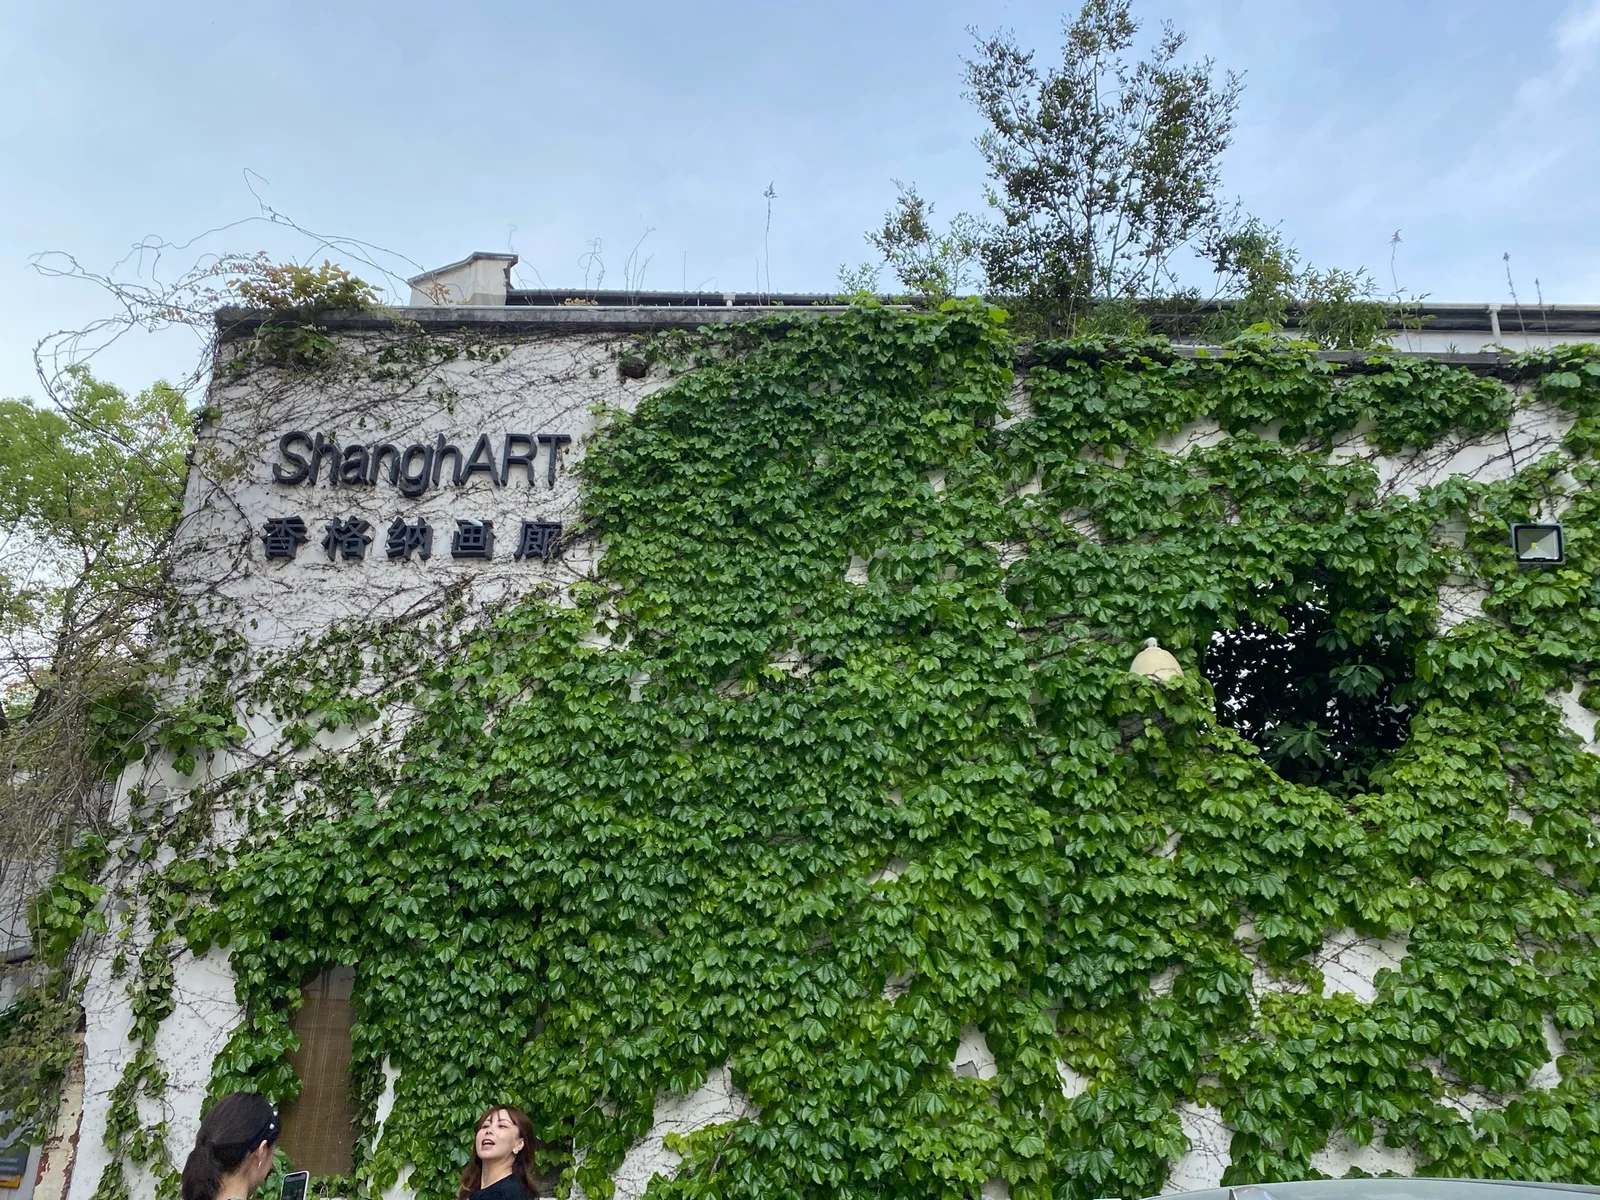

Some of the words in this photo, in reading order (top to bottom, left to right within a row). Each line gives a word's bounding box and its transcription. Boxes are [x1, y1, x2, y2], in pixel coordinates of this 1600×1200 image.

[272, 430, 571, 497] ShanghART
[261, 515, 562, 562] 香格纳画廊
